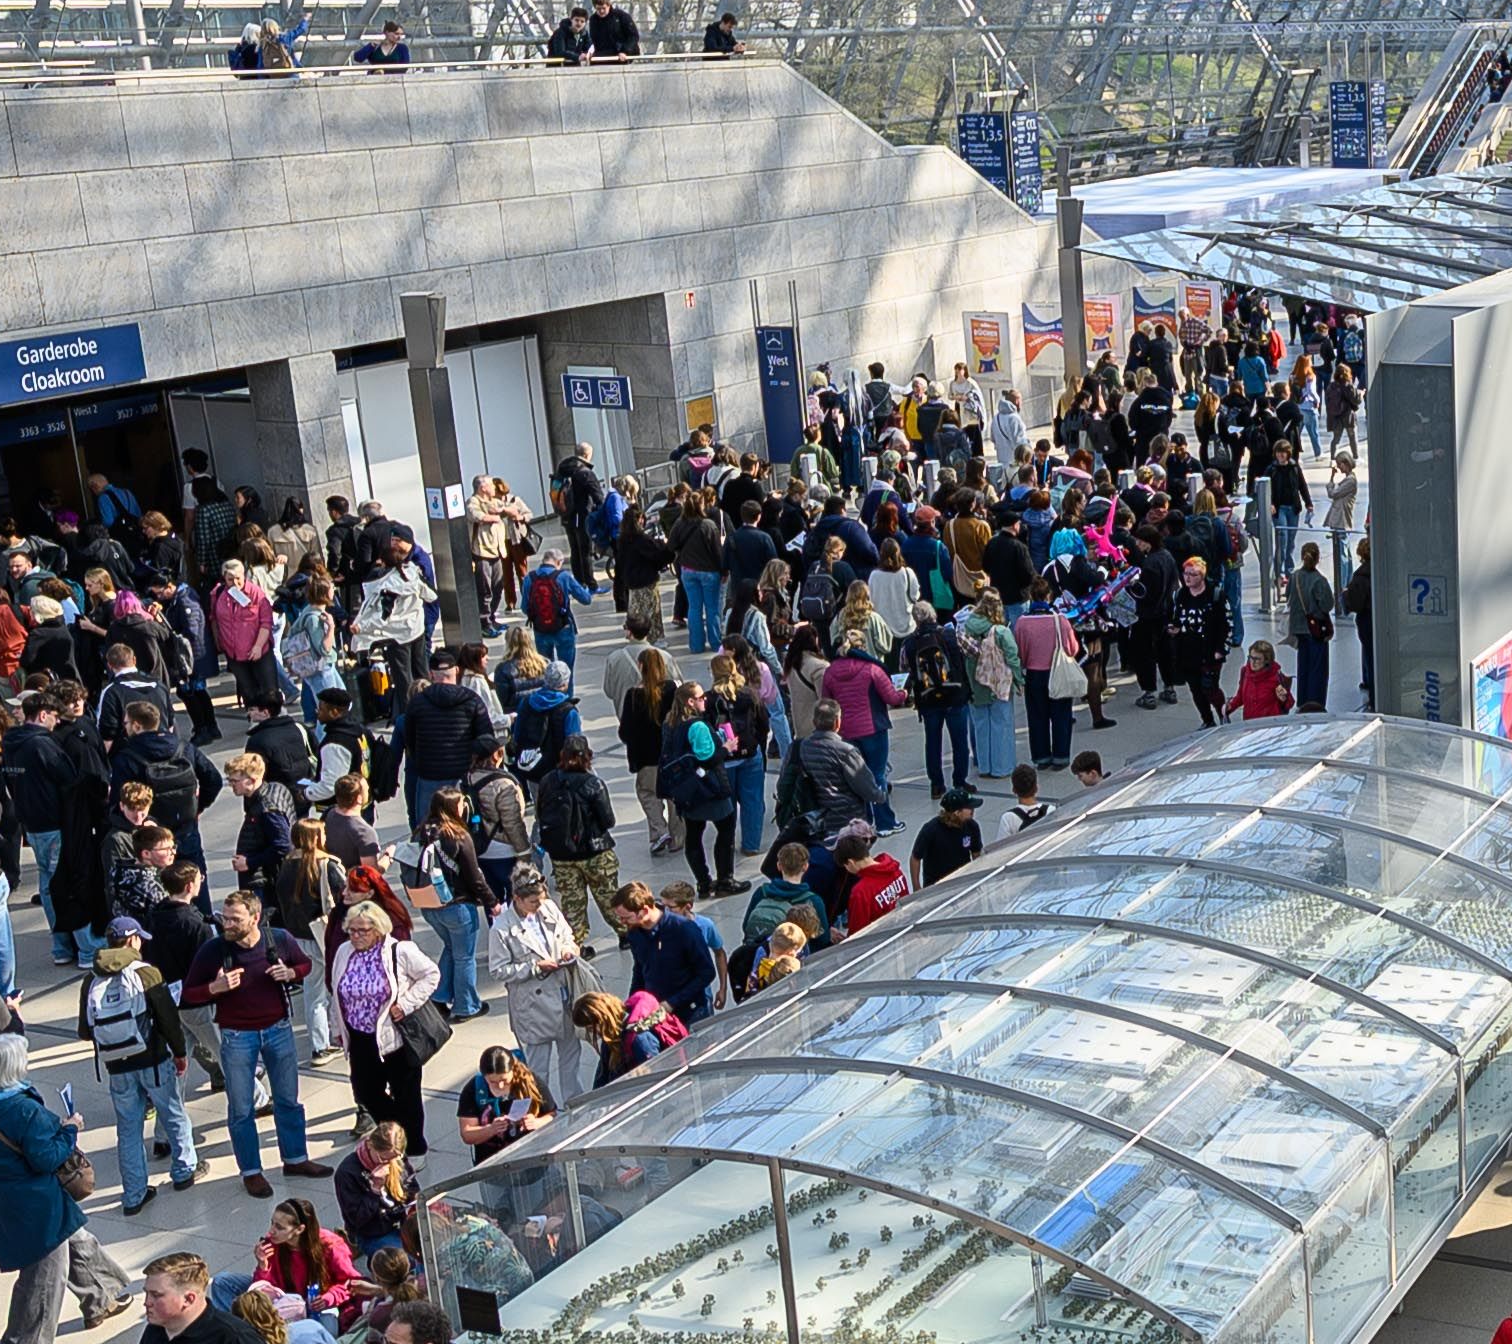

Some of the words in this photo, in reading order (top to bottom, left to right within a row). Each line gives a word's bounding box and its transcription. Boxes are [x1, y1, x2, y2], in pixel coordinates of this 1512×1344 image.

[980, 117, 995, 128] 2,4
[982, 130, 1003, 142] 1,3,5
[16, 337, 98, 366] Garderobe
[767, 355, 789, 366] West
[21, 364, 105, 393] Cloakroom
[769, 365, 775, 376] 2
[1423, 670, 1440, 722] ation
[875, 875, 907, 909] PEANUT
